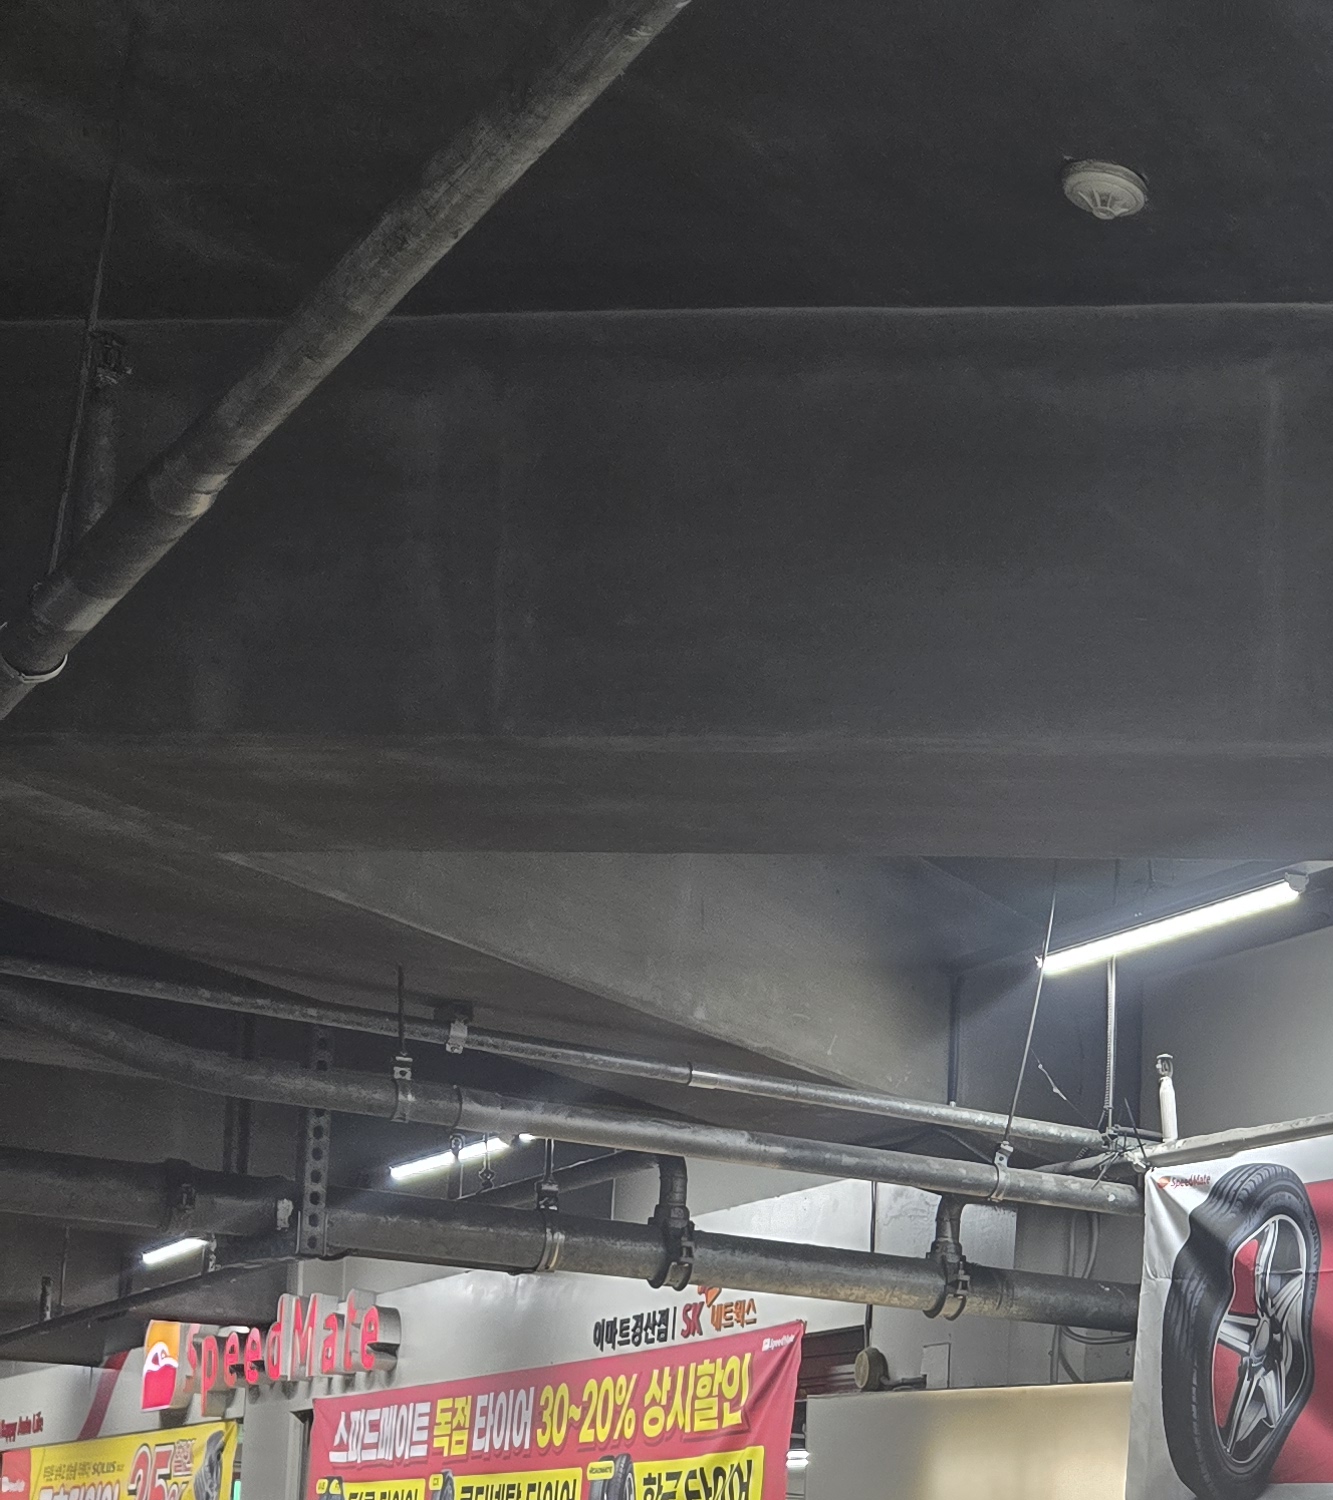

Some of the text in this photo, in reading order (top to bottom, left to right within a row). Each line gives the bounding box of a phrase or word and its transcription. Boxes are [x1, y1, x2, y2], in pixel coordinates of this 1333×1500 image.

[184, 1293, 380, 1416] SpeedMate
[593, 1308, 669, 1351] 이마트경산점
[680, 1302, 705, 1338] SK
[329, 1352, 752, 1463] 스피드메이트 독점 타이어 30~20% 상시할인
